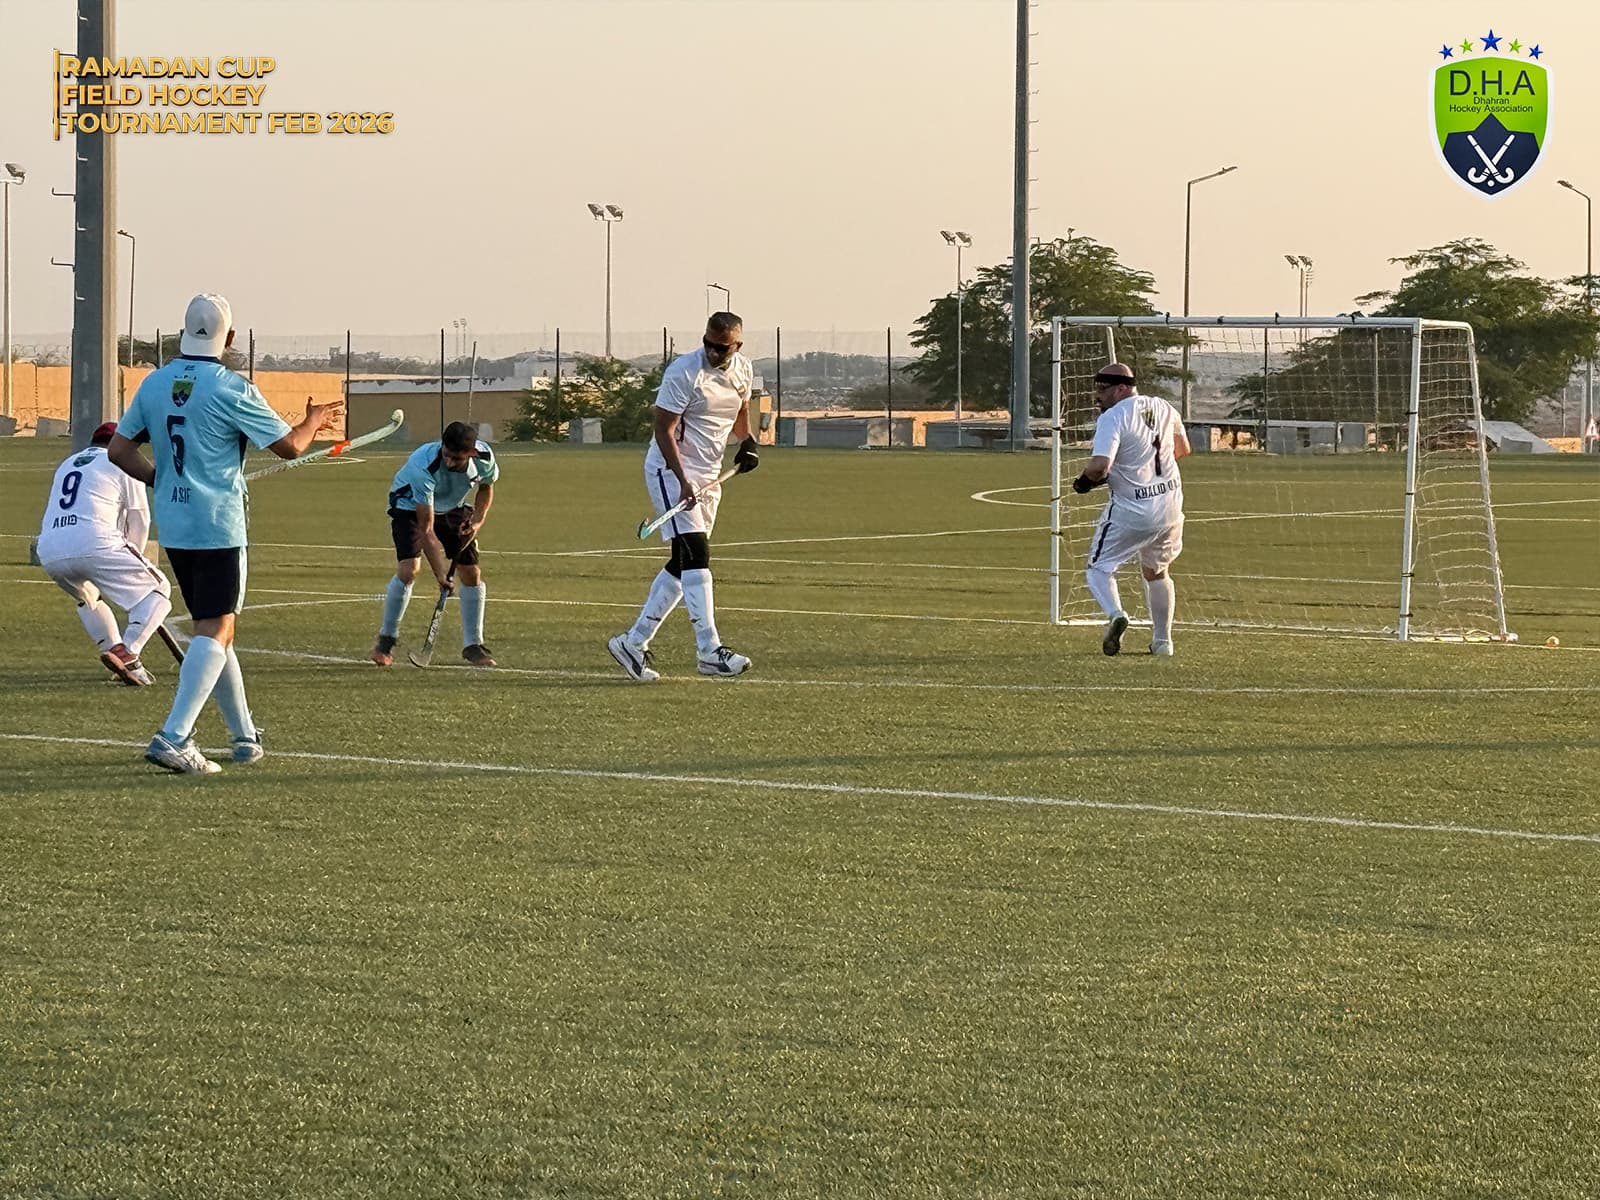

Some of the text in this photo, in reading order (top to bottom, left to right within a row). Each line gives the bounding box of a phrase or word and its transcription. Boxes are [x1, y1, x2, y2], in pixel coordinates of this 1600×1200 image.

[167, 415, 186, 477] 5
[1152, 434, 1161, 476] 1
[59, 471, 83, 510] 9
[171, 486, 192, 503] ASIF
[1135, 482, 1167, 500] KHALID
